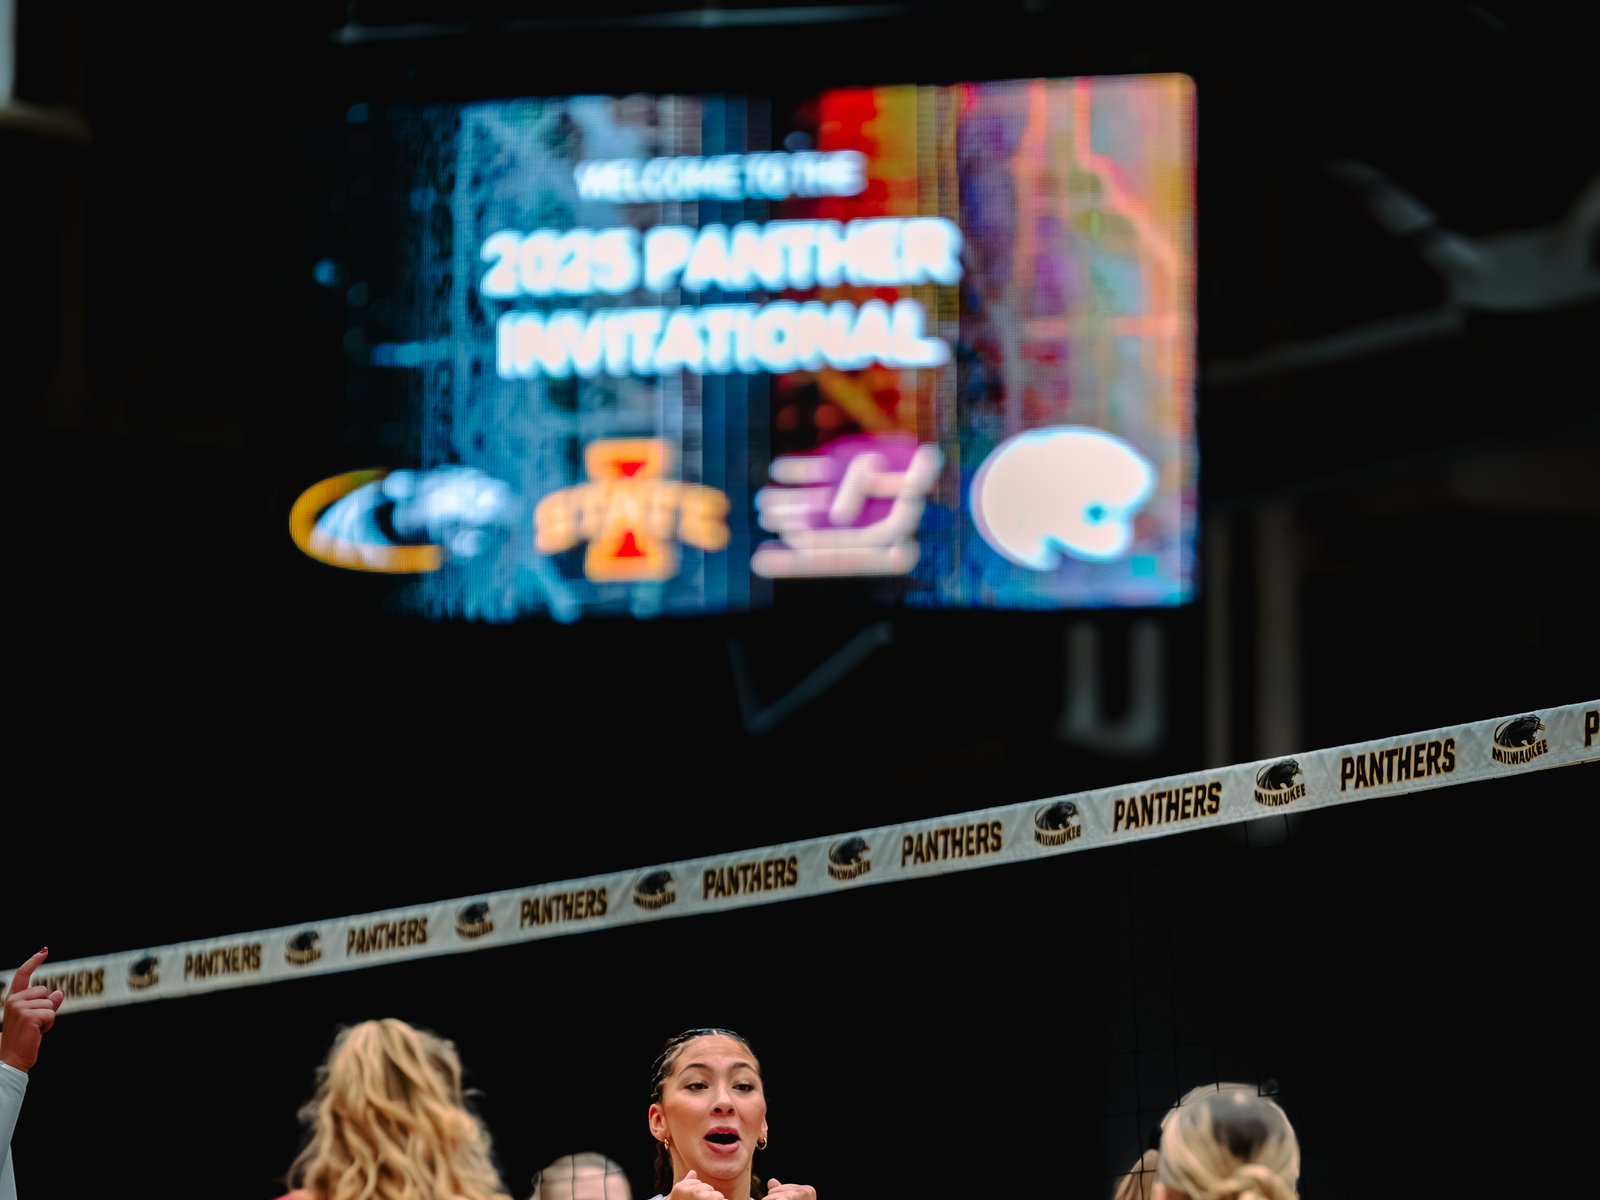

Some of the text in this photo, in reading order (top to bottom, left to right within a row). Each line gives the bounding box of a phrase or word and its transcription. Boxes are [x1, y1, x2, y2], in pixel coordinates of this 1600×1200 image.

[573, 150, 867, 203] WELCOME TO THE
[480, 216, 963, 298] 2025 PANTHER
[496, 299, 949, 379] INVITATIONAL
[1491, 739, 1549, 766] MILWAUKEE
[1253, 783, 1307, 808] MILWAUKEE
[184, 943, 262, 982] PANTHERS
[346, 917, 429, 955] PANTHERS
[519, 886, 608, 928] PANTHERS
[702, 855, 798, 900] PANTHERS
[901, 820, 1004, 868] PANTHERS
[1112, 780, 1223, 833] PANTHERS
[1340, 737, 1456, 792] PANTHERS
[1033, 824, 1082, 847] MILWAUKEE
